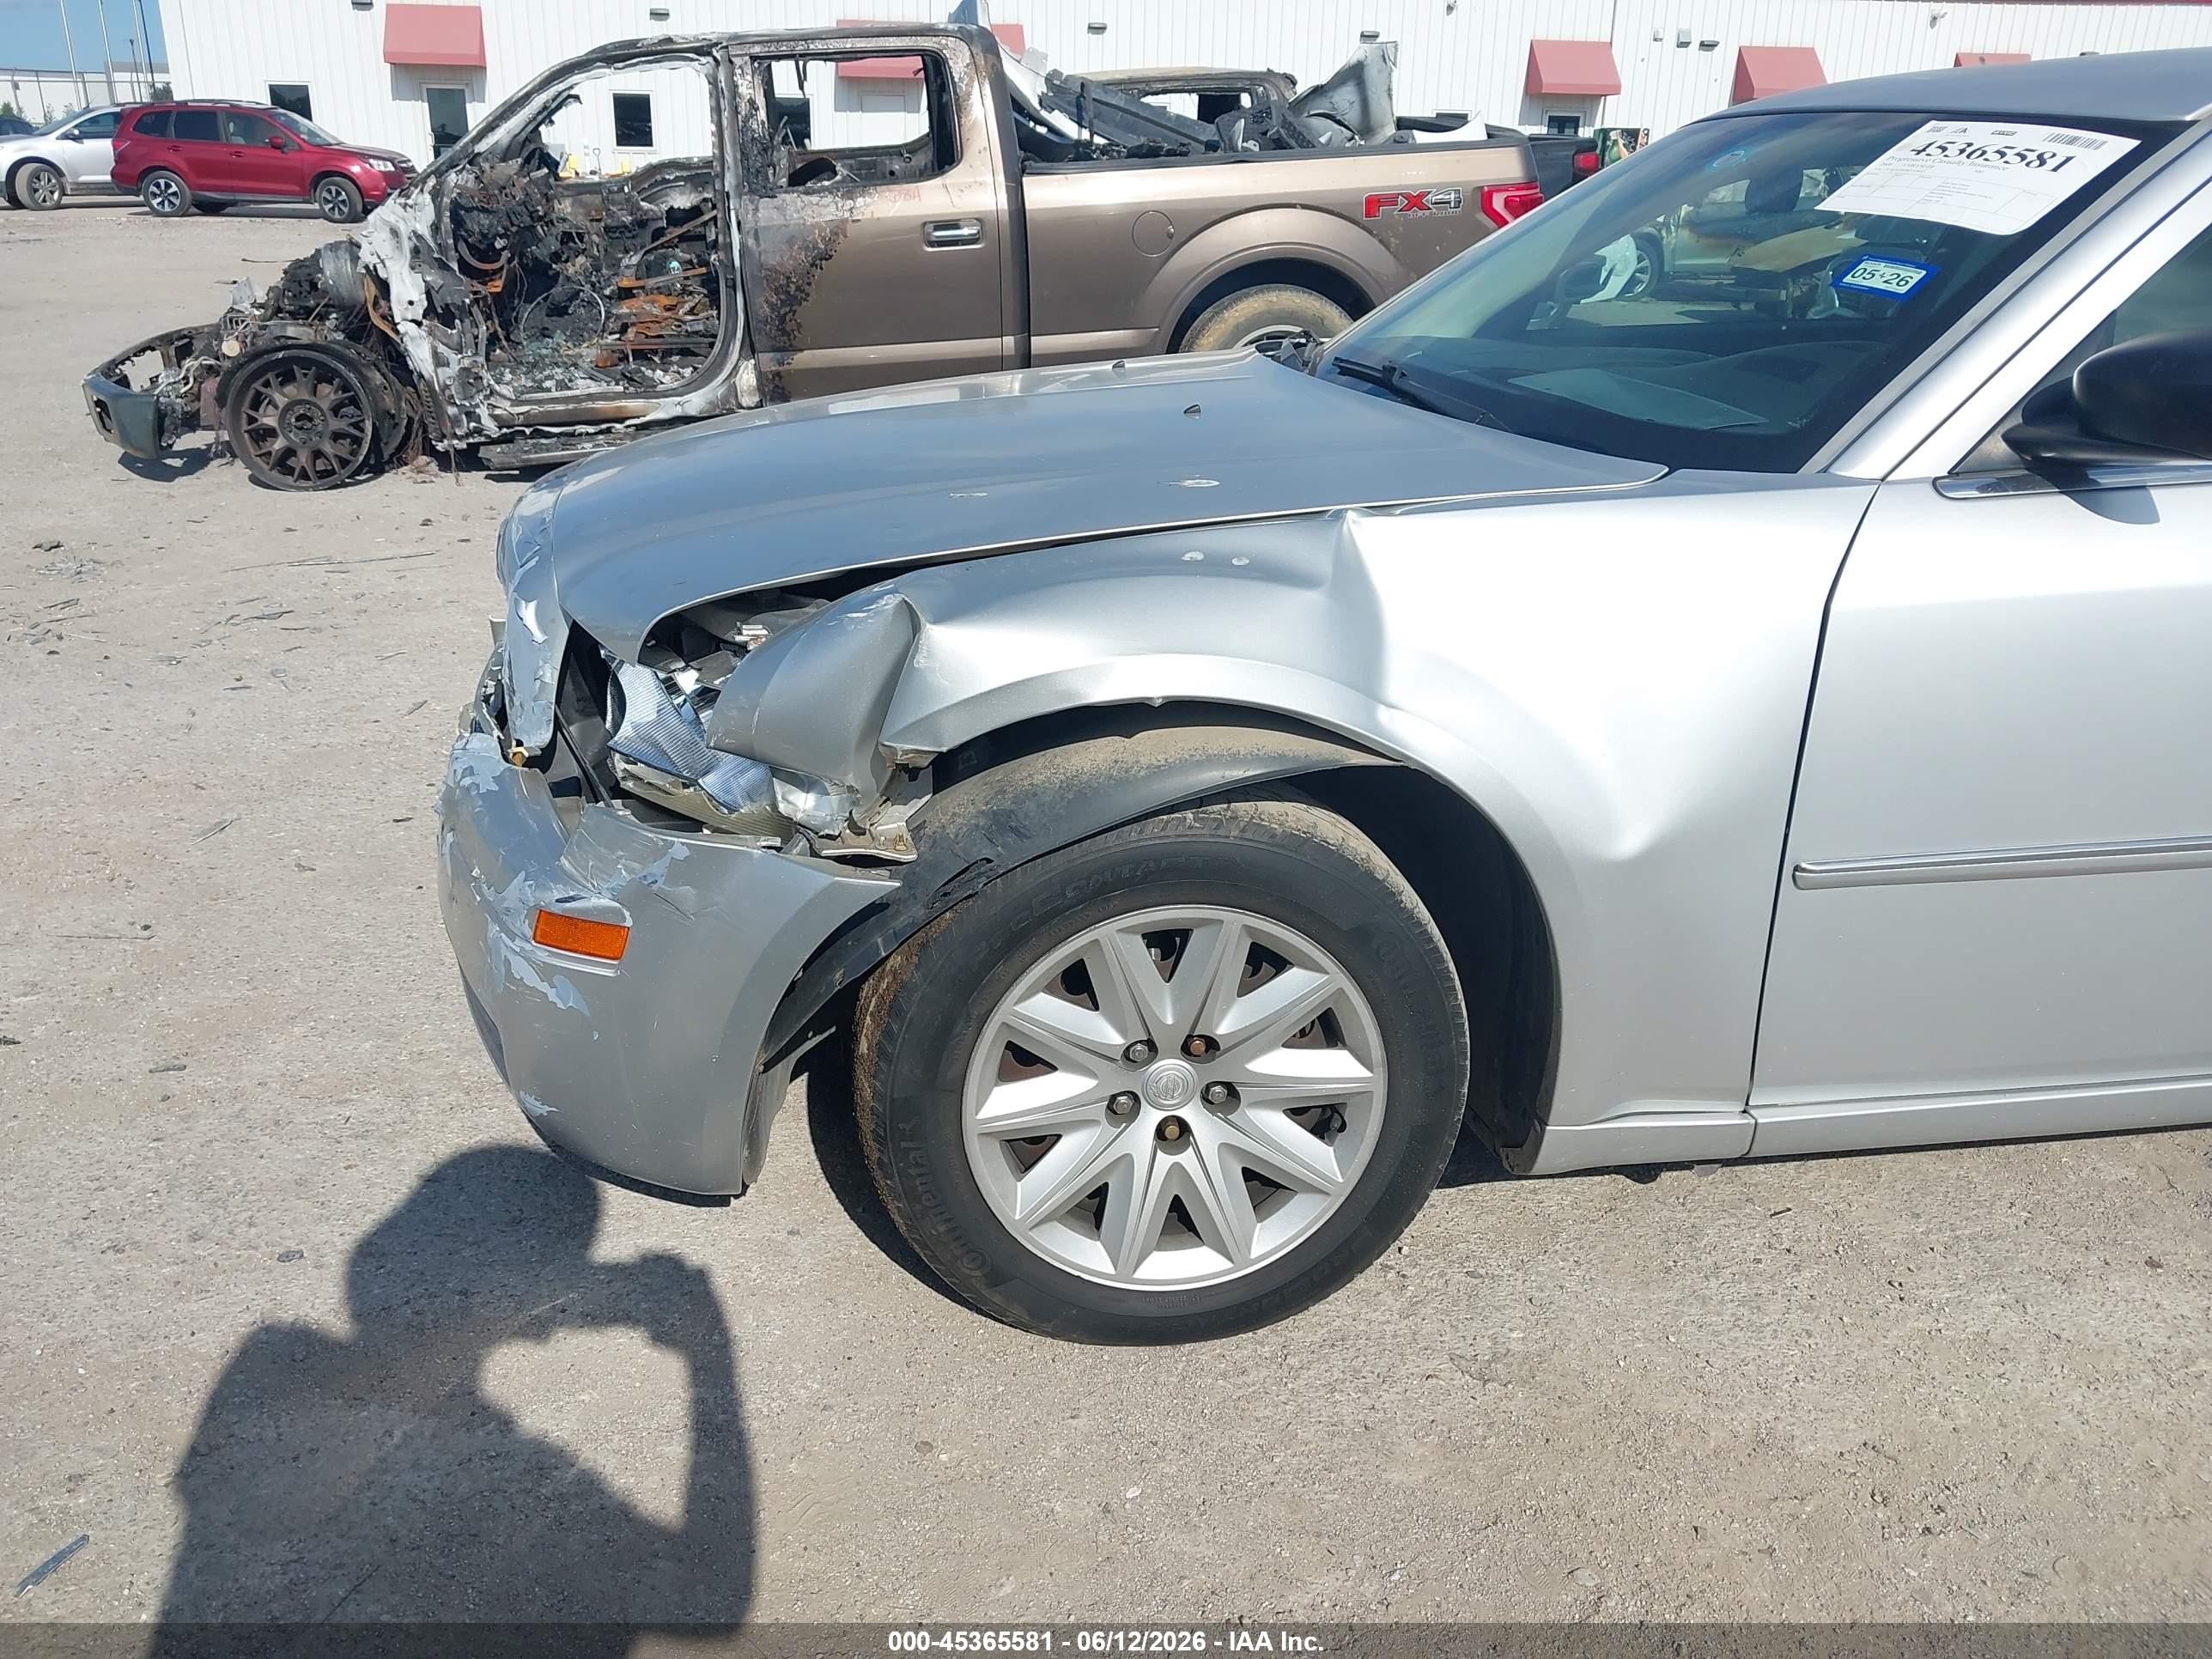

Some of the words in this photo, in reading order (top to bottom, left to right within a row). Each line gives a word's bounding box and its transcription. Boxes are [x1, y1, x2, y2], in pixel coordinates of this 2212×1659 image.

[1910, 140, 2076, 173] 45365581
[1363, 186, 1463, 220] FX4
[1850, 267, 1881, 281] 05
[1881, 272, 1914, 288] 26
